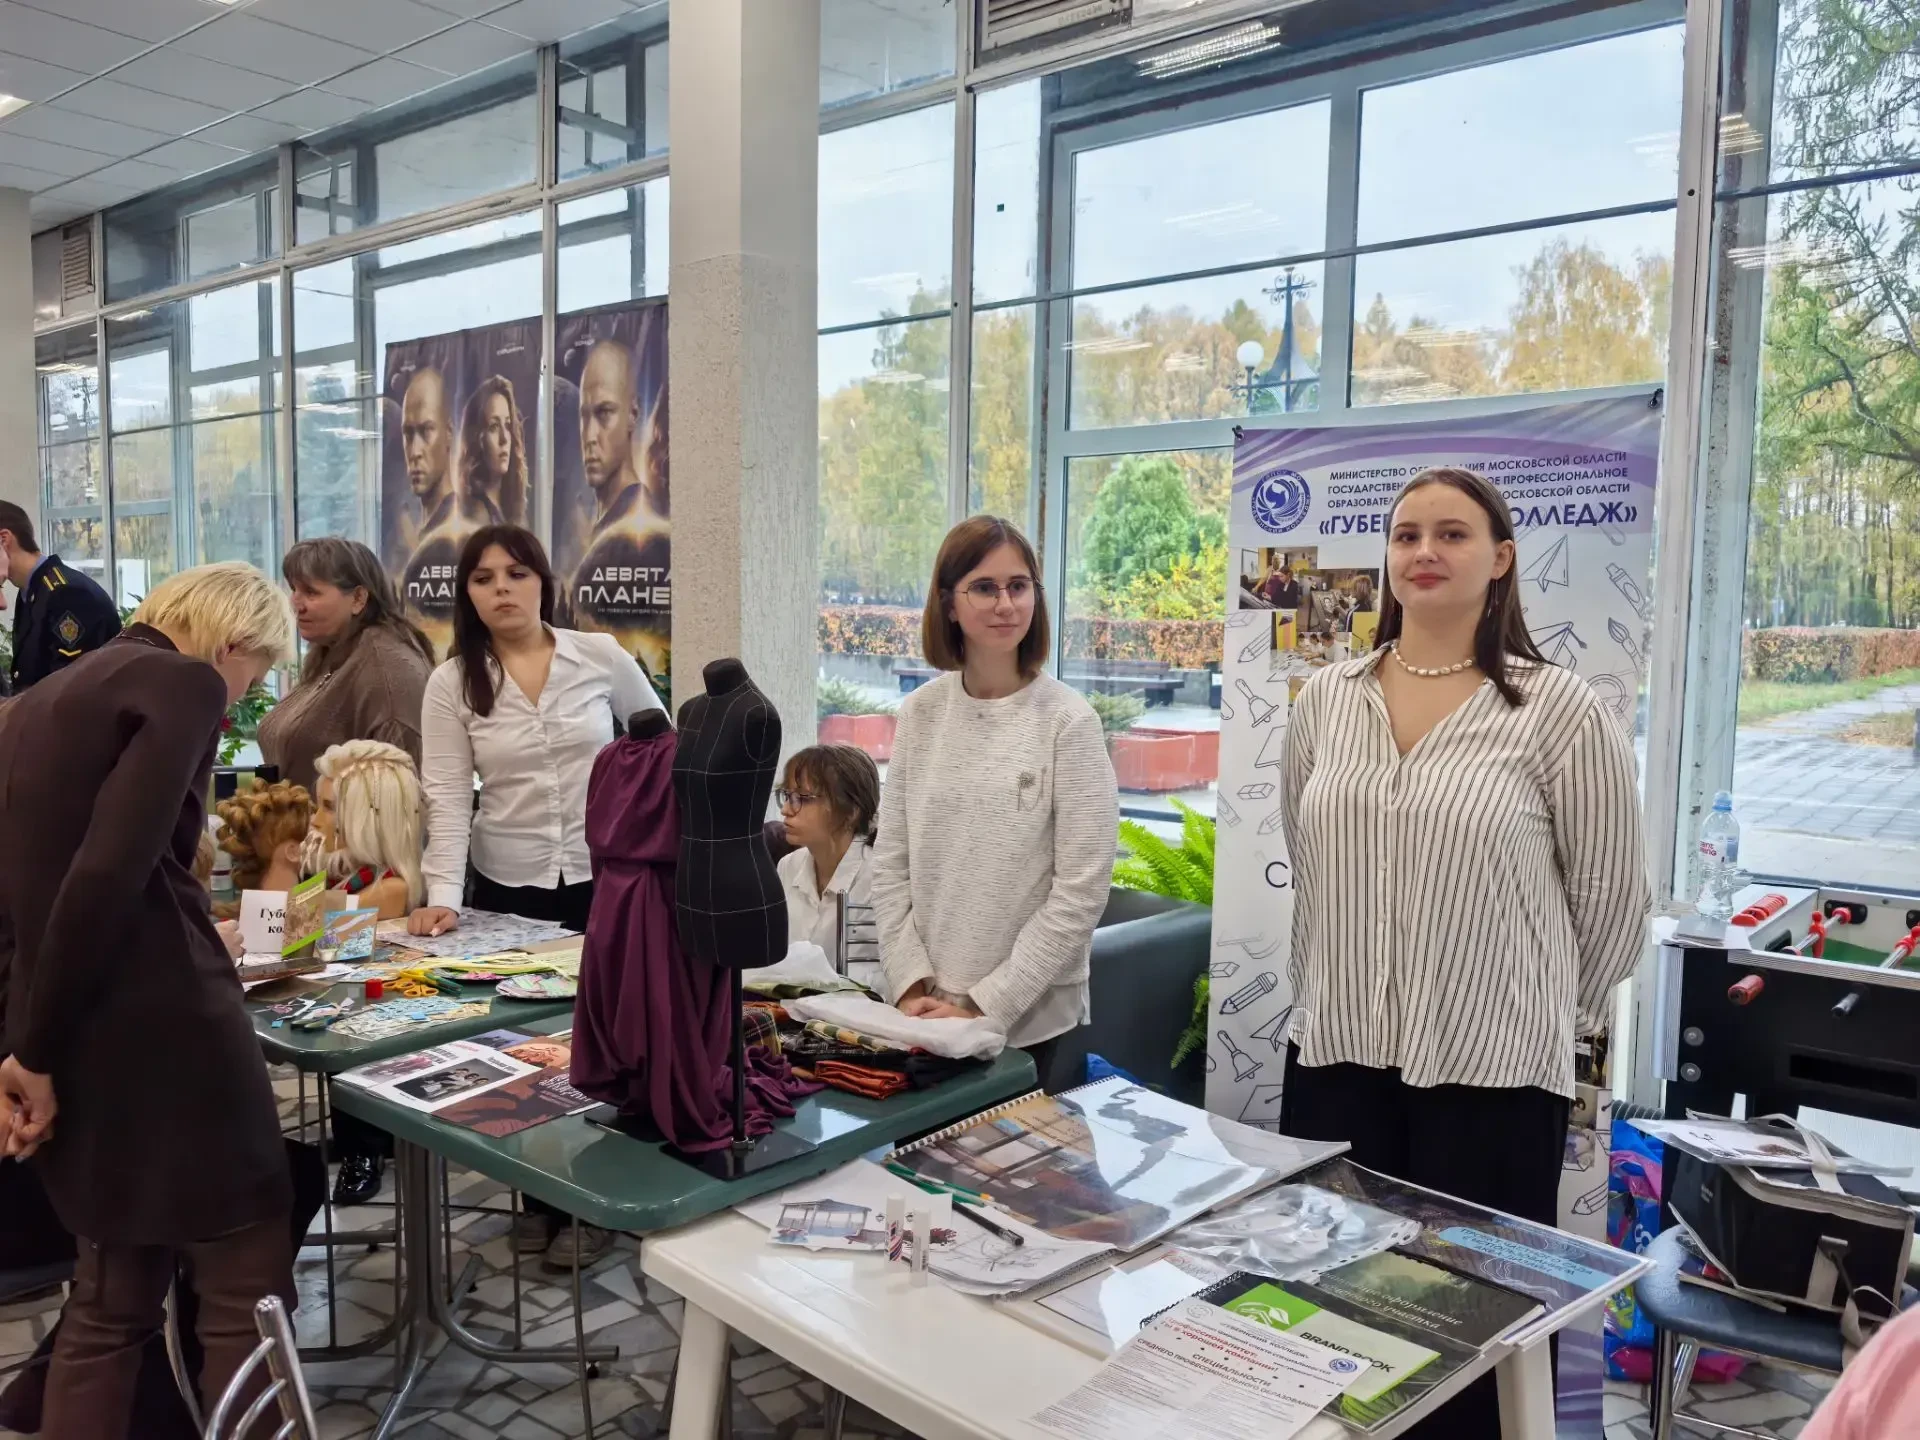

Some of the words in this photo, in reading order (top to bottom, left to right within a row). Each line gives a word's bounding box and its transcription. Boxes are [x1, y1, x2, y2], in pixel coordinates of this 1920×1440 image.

[1329, 467, 1407, 480] МИНИСТЕРСТВО
[1487, 457, 1570, 472] МОСКОВСКОЙ
[1573, 451, 1627, 465] ОБЛАСТИ
[1328, 482, 1407, 495] ГОСУДАРСТВЕН
[1503, 467, 1629, 486] ПРОФЕССИОНАЛЬНОЕ
[1328, 496, 1394, 509] ОБРАЗОВАТЕЛ
[1502, 486, 1573, 500] ОСКОВСКОЙ
[1576, 483, 1631, 496] ОБЛАСТИ
[1319, 513, 1389, 535] «ГУБЕ
[1510, 500, 1638, 528] ОЛЛЕДЖ»
[591, 566, 671, 582] ДЕВЯТ
[578, 585, 671, 605] ПЛАНЕ
[1181, 1330, 1224, 1351] хорошей
[1299, 1331, 1350, 1355] BRAND
[1192, 1353, 1272, 1388] СПЕЦИАЛЬНОСТИ
